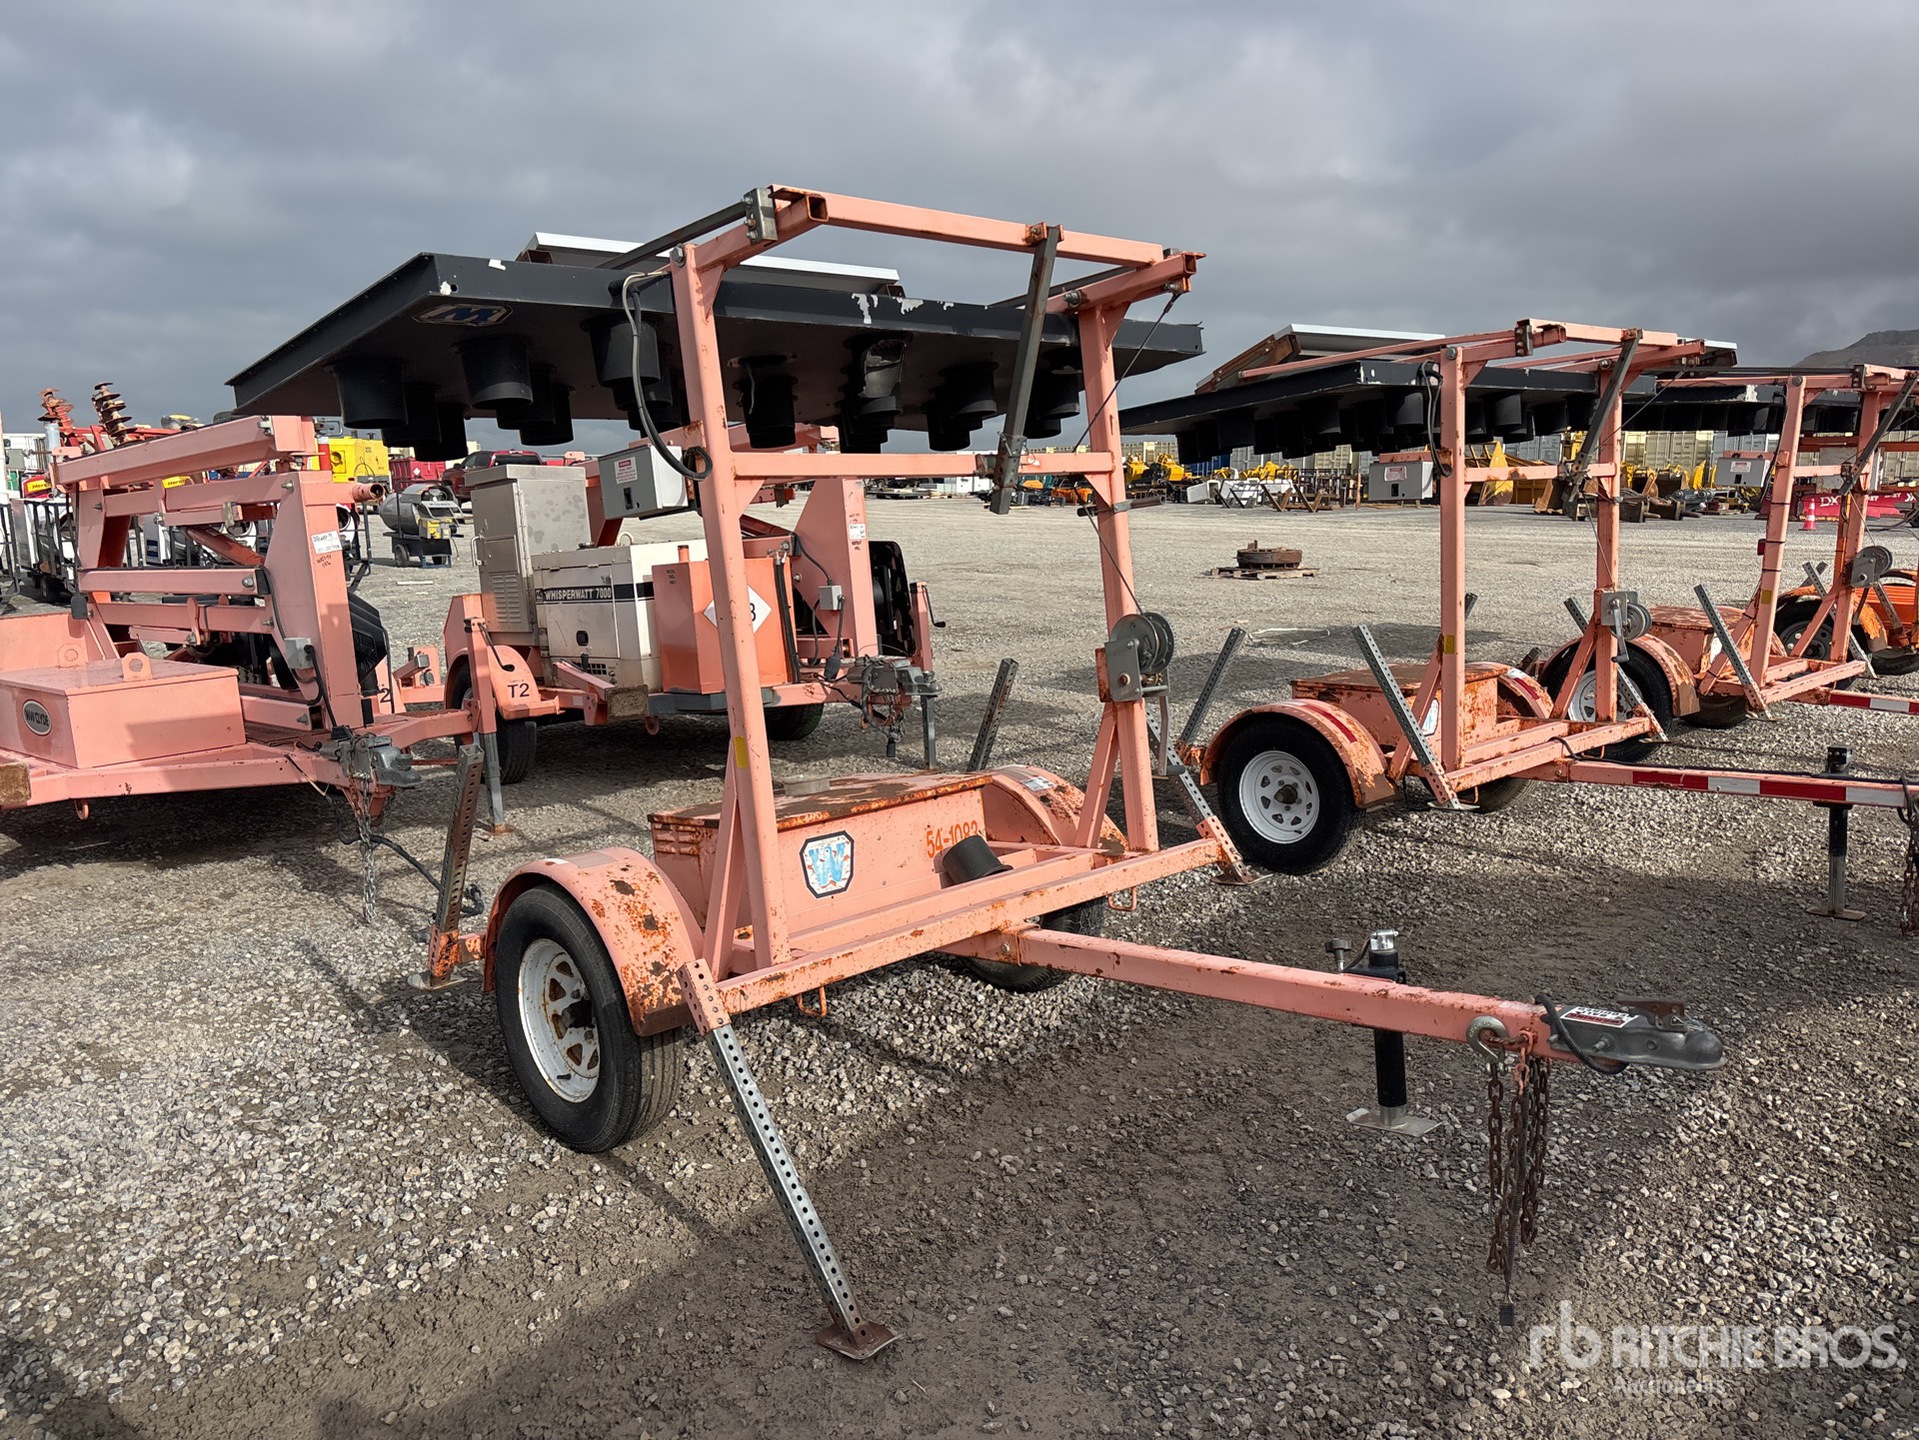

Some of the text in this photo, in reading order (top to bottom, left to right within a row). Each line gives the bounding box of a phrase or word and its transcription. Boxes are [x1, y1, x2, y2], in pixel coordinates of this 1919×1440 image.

[544, 587, 611, 600] WHISPERWATT 7000
[507, 682, 530, 698] T2
